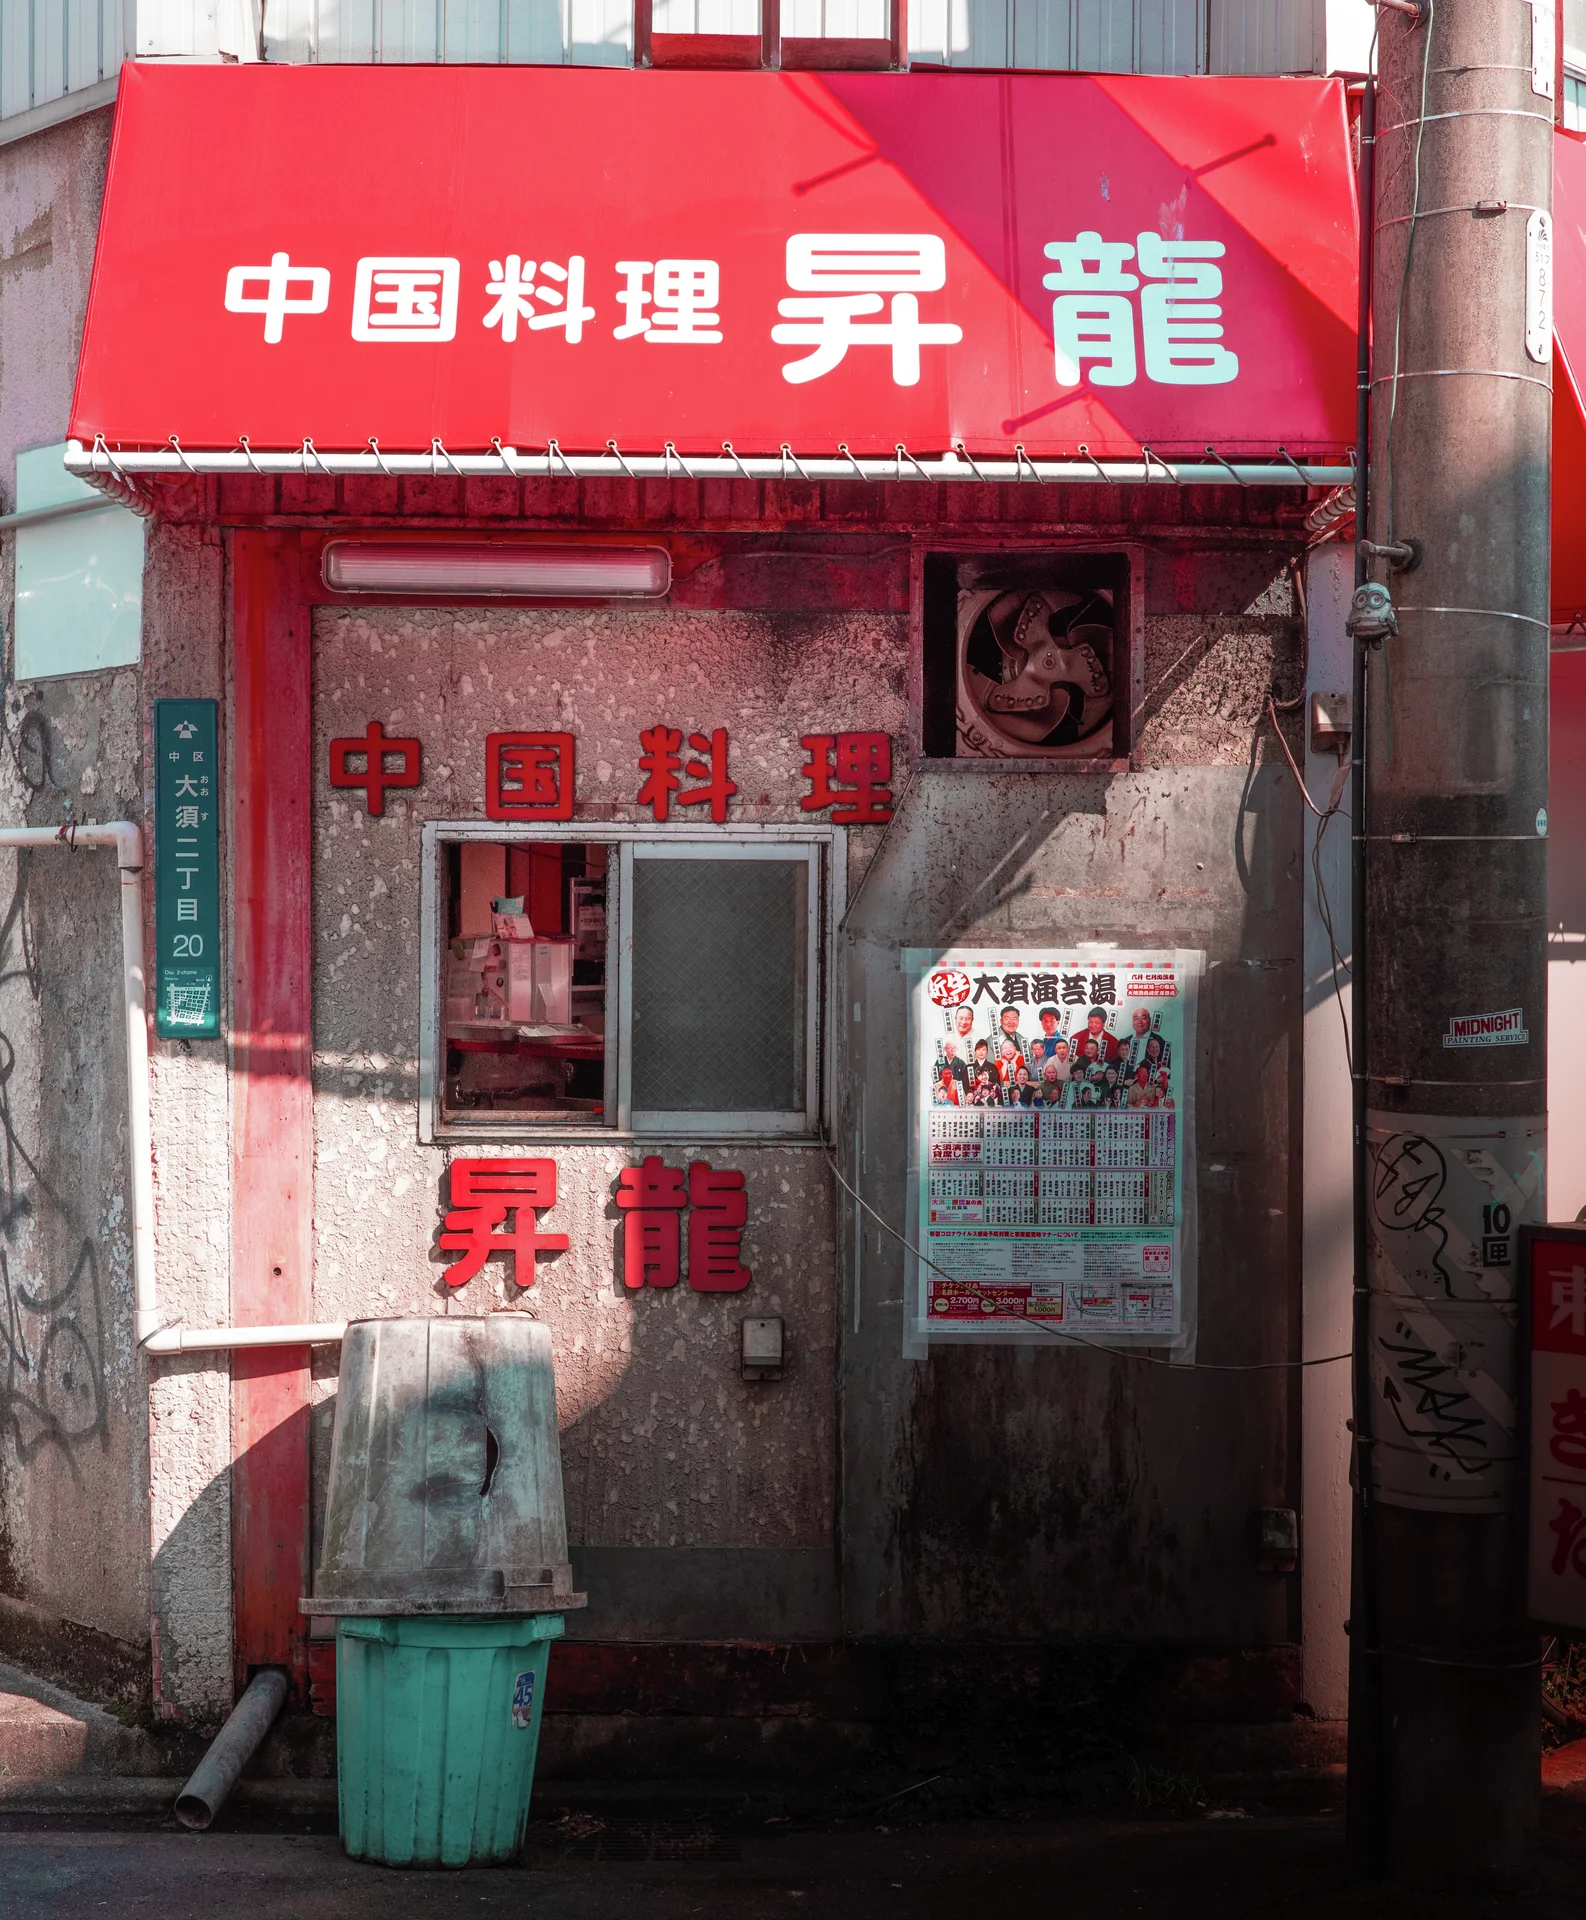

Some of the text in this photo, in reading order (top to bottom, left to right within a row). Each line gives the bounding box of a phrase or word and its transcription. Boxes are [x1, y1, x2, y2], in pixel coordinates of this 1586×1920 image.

[224, 231, 1239, 388] 中国料理 昇龍
[168, 752, 204, 762] 中区
[329, 721, 897, 825] 中国料理
[174, 774, 200, 922] 大須二丁目
[172, 934, 204, 957] 20
[971, 971, 1117, 1006] 大須演芸場
[1447, 1033, 1526, 1044] PAINTING SERVICE
[1454, 1012, 1519, 1037] MIDNIGHT
[440, 1156, 750, 1292] 昇龍
[1483, 1204, 1511, 1235] 10
